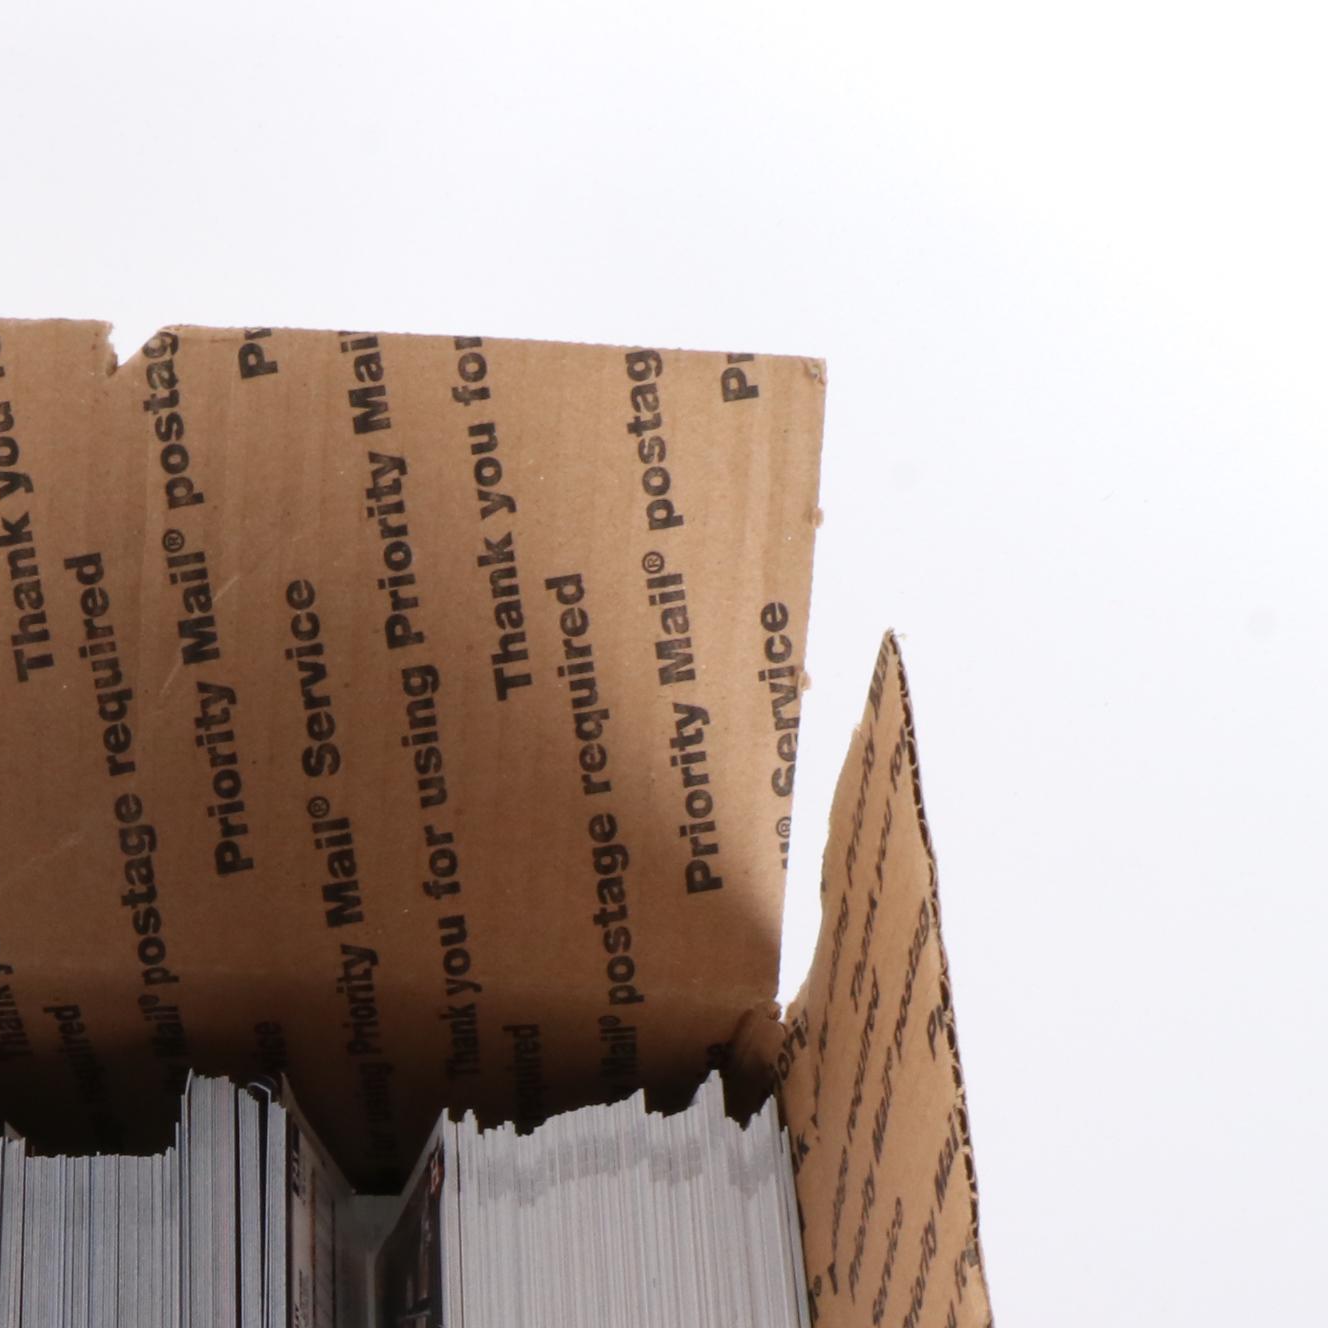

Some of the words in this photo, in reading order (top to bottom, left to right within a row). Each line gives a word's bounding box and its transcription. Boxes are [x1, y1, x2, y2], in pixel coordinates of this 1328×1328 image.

[143, 332, 204, 509] postag
[339, 333, 391, 434] Mai
[468, 423, 516, 519] you
[162, 529, 220, 665] Mail®
[366, 451, 424, 649] Priority
[477, 532, 532, 701] Thank
[642, 552, 695, 685] Mail®
[64, 552, 135, 776] required
[285, 580, 340, 777] Service
[401, 665, 447, 809] using
[545, 574, 611, 795] required
[758, 602, 800, 798] Service
[194, 682, 253, 875] Priority
[306, 796, 363, 928] Mail®
[422, 825, 460, 900] for
[670, 703, 722, 894] Priority
[115, 794, 179, 986] postage
[438, 915, 482, 996] you
[589, 814, 644, 1005] postage
